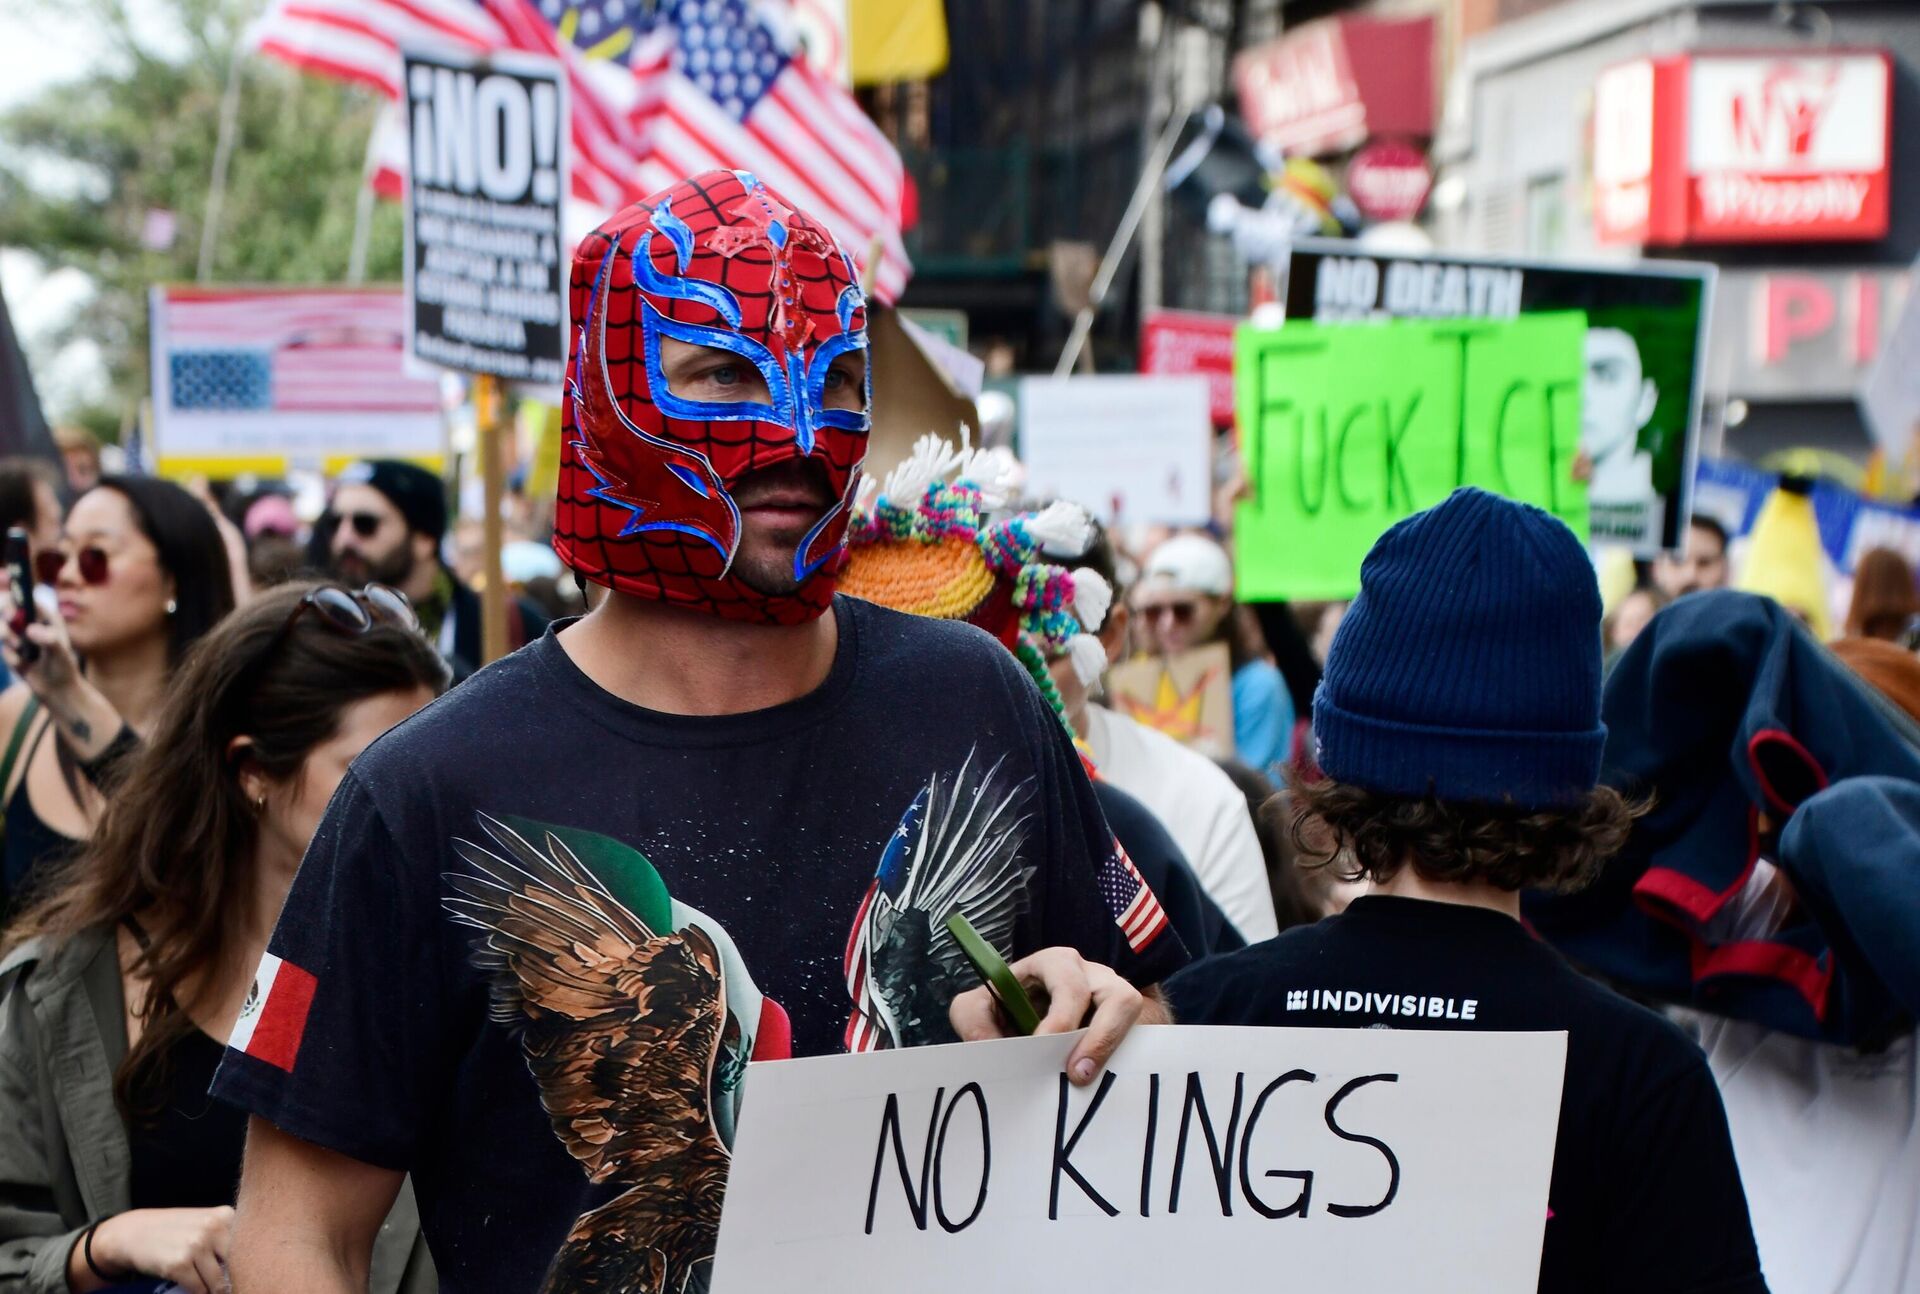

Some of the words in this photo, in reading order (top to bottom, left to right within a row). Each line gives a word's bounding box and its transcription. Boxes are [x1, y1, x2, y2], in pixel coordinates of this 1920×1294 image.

[409, 63, 558, 205] ¡NO!
[1316, 255, 1380, 308] NO
[1385, 259, 1523, 320] DEATH
[1312, 989, 1478, 1021] INDIVISIBLE
[864, 1081, 992, 1235] NO
[1048, 1068, 1400, 1219] KINGS
